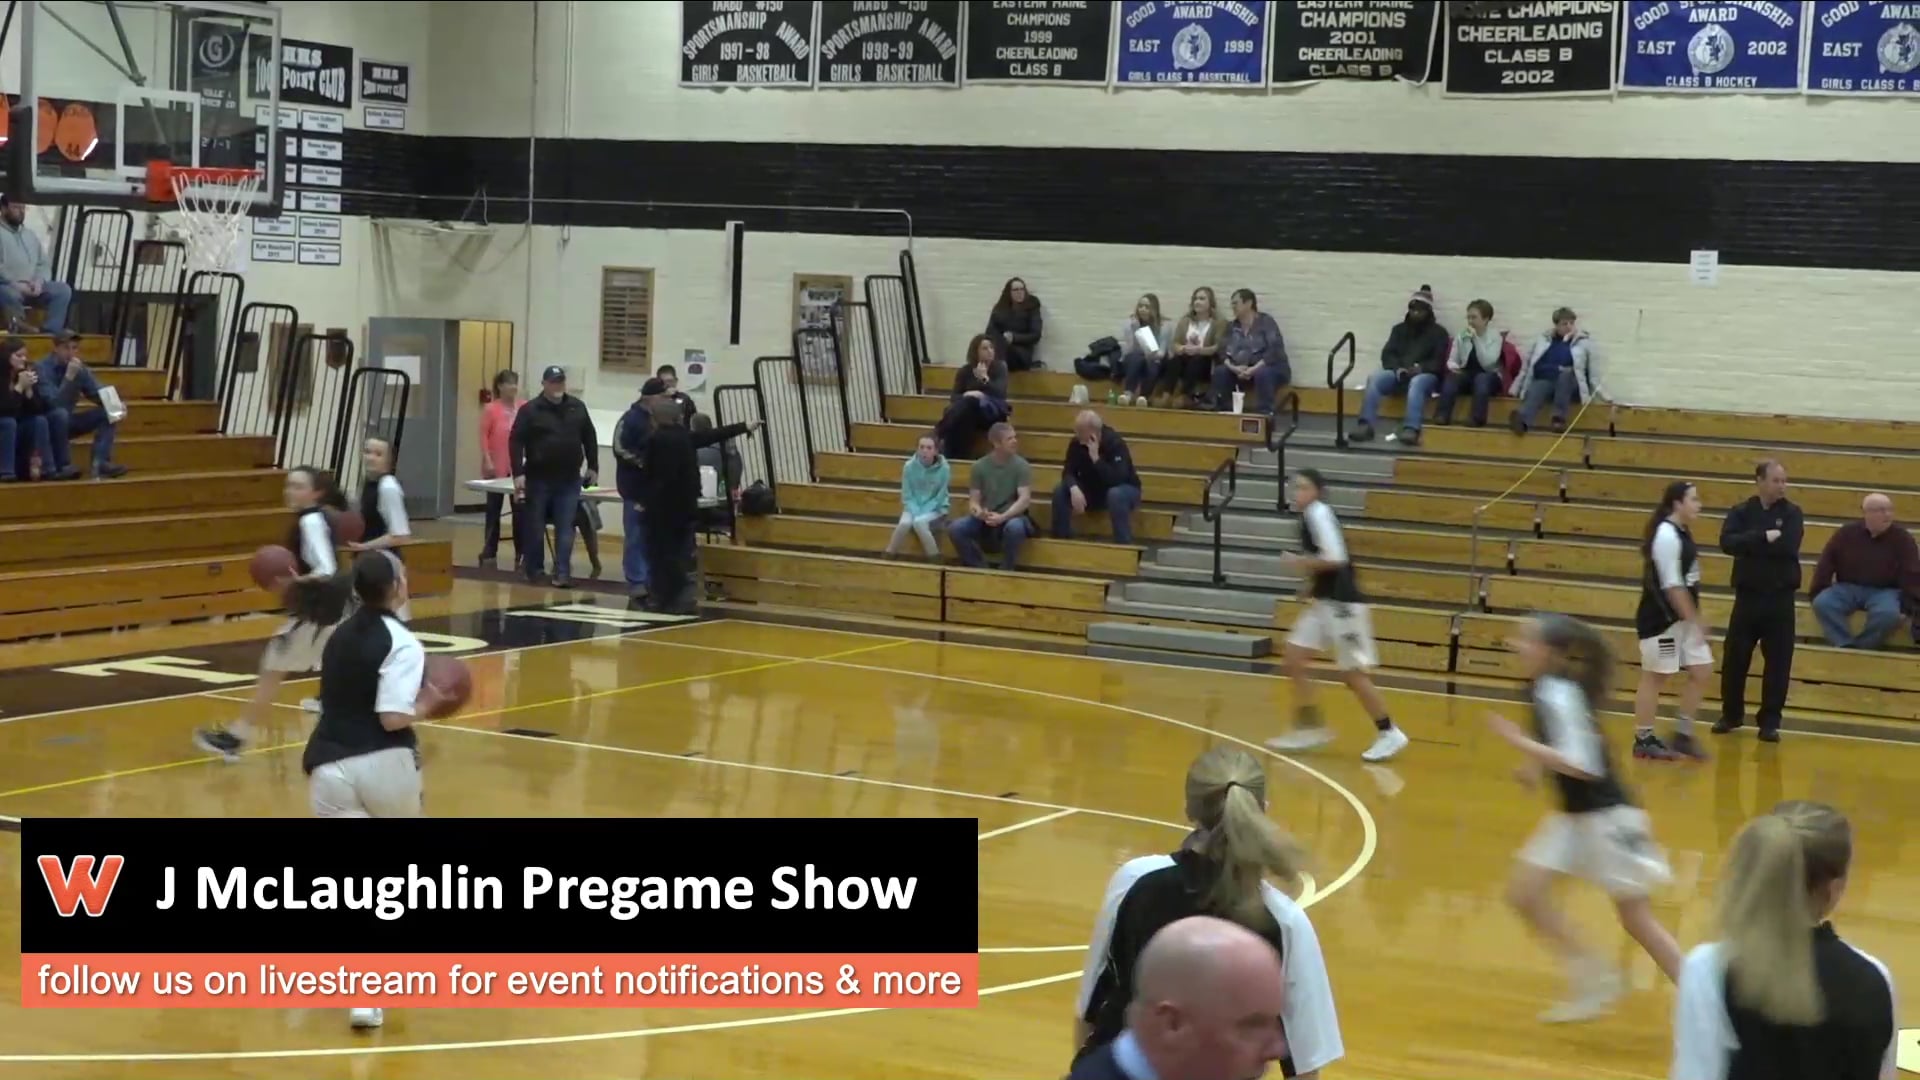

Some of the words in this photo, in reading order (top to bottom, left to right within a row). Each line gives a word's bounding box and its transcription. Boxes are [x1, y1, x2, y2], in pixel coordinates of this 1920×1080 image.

[1007, 13, 1071, 26] CHAMPIONS
[1126, 2, 1156, 28] GOOD
[1173, 5, 1213, 19] AWARD
[1301, 11, 1406, 28] CHAMPIONS
[1634, 2, 1671, 31] GOOD
[1688, 7, 1738, 23] AWARD
[1821, 1, 1860, 28] GOOD
[682, 11, 767, 60] SPORTSMANSHIP
[775, 20, 810, 60] AWARD
[821, 11, 913, 60] SPORTSMANSHIP
[918, 17, 957, 60] AWARD
[1024, 30, 1053, 43] 1999
[1329, 31, 1377, 45] 2001
[1457, 21, 1603, 43] CHEERLEADING
[996, 47, 1078, 60] CHEERLEADING
[1129, 39, 1160, 53] EAST
[1224, 40, 1254, 54] 1999
[1298, 47, 1403, 61] CHEERLEADING
[1637, 40, 1676, 55] EAST
[1747, 41, 1788, 56] 2002
[1822, 42, 1863, 57] EAST
[1484, 48, 1550, 63] CLASS
[1559, 47, 1573, 62] B
[692, 64, 719, 81] GIRLS
[736, 64, 797, 81] BASKETBALL
[830, 64, 861, 81] GIRLS
[876, 64, 943, 81] BASKETBALL
[1009, 63, 1048, 76] CLASS
[1053, 64, 1062, 76] B
[1128, 72, 1151, 82] GIRLS
[1156, 72, 1182, 82] CLASS
[1198, 72, 1251, 82] BASKETBALL
[1309, 64, 1373, 77] CLASS
[1379, 64, 1393, 77] B
[282, 66, 316, 92] POINT
[319, 67, 346, 103] CLUB
[1501, 70, 1555, 85] 2002
[1666, 76, 1700, 87] CLASS
[1704, 76, 1712, 87] B
[1716, 76, 1758, 88] HOCKEY
[1821, 78, 1853, 90] GIRLS
[1860, 79, 1895, 90] CLASS
[1898, 79, 1906, 90] C
